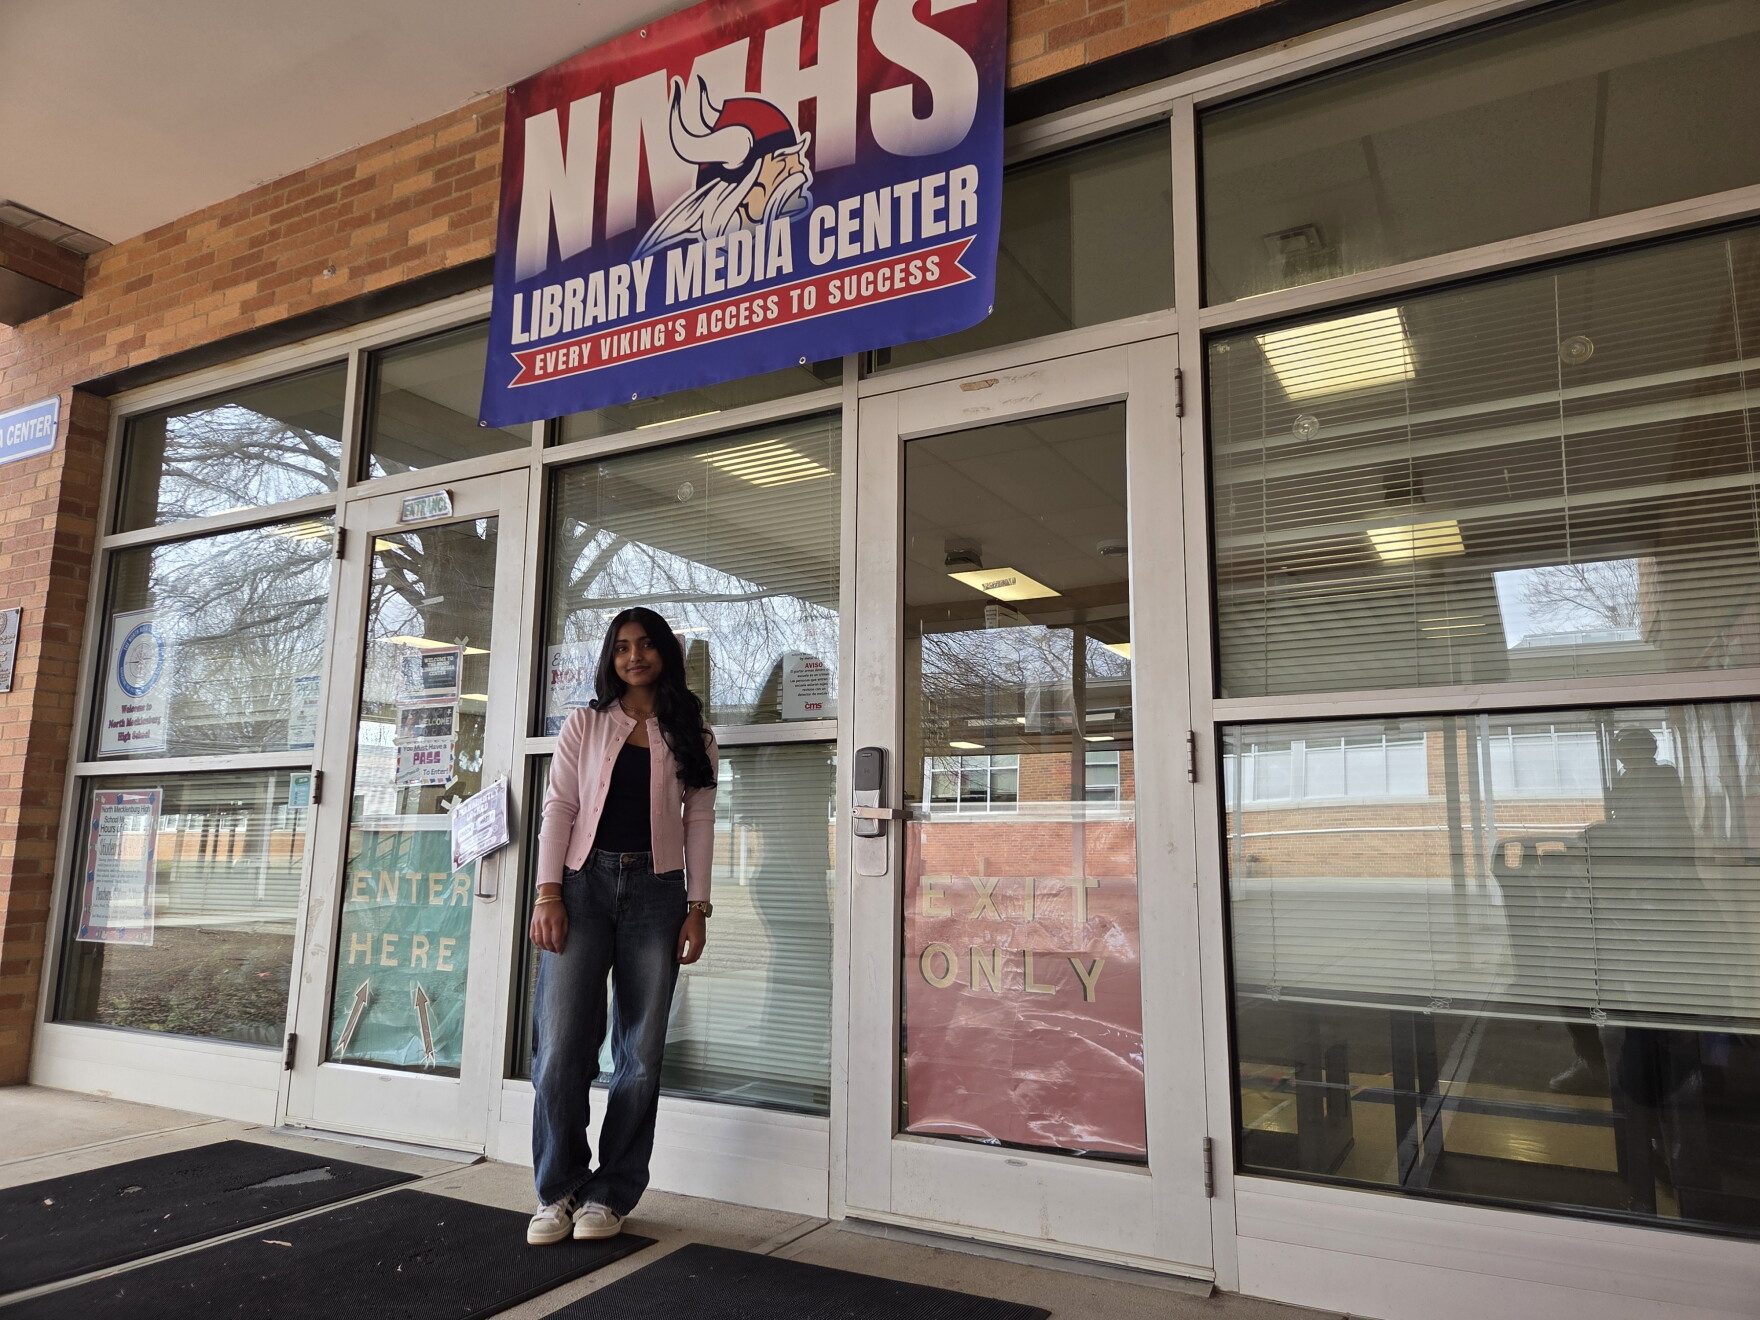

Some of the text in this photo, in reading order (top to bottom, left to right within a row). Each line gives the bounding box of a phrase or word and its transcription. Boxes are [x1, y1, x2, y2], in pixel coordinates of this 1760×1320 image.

[516, 0, 980, 284] NMHS
[511, 164, 979, 345] LIBRARY MEDIA CENTER
[534, 255, 940, 376] EVERY VIKING'S ACCESS TO SUCCESS
[6, 415, 52, 446] CENTER
[404, 496, 448, 517] ENTRANC
[121, 702, 152, 714] Welcome to
[108, 719, 126, 729] North
[117, 731, 131, 743] High
[413, 750, 441, 765] PASS
[104, 815, 118, 824] School
[141, 803, 151, 814] High
[100, 823, 116, 834] Hours
[352, 870, 471, 907] ENTER
[920, 874, 1100, 923] EXIT
[348, 932, 457, 972] HERE
[919, 942, 1105, 1003] ONLY
